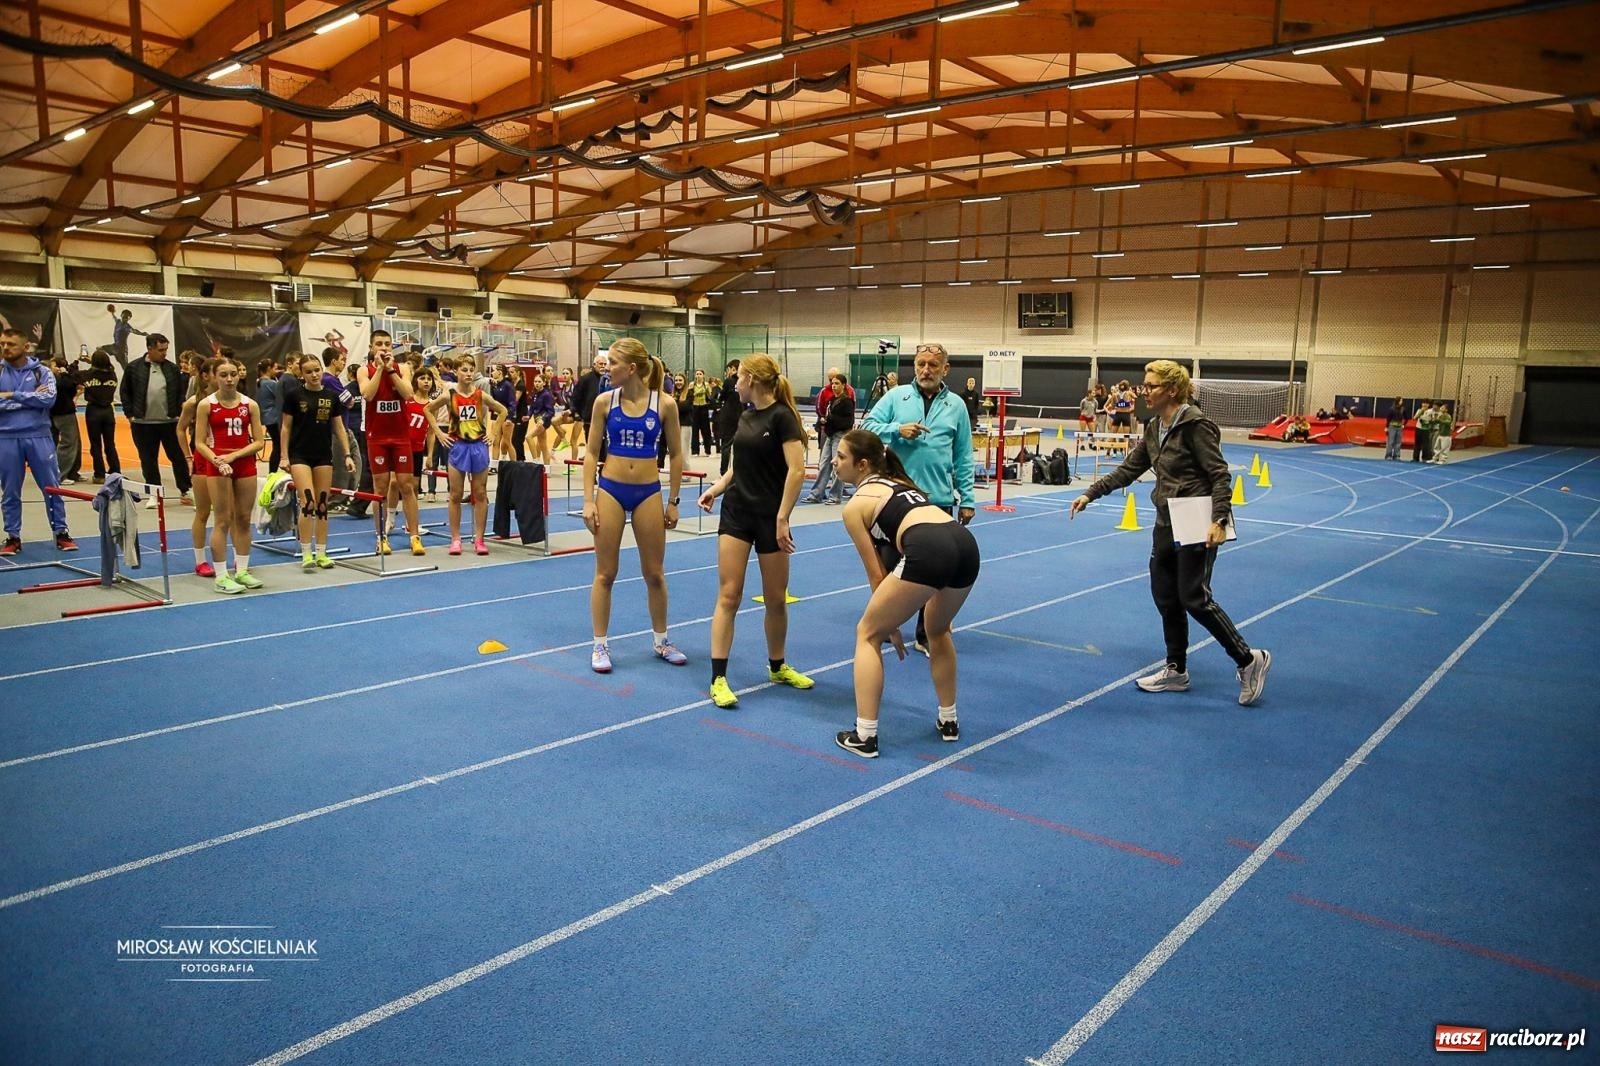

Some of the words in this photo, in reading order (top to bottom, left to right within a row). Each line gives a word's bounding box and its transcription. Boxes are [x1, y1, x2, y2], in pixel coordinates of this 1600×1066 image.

[379, 401, 399, 412] 880
[460, 405, 477, 420] 42
[409, 412, 425, 429] 77
[896, 489, 927, 505] 75
